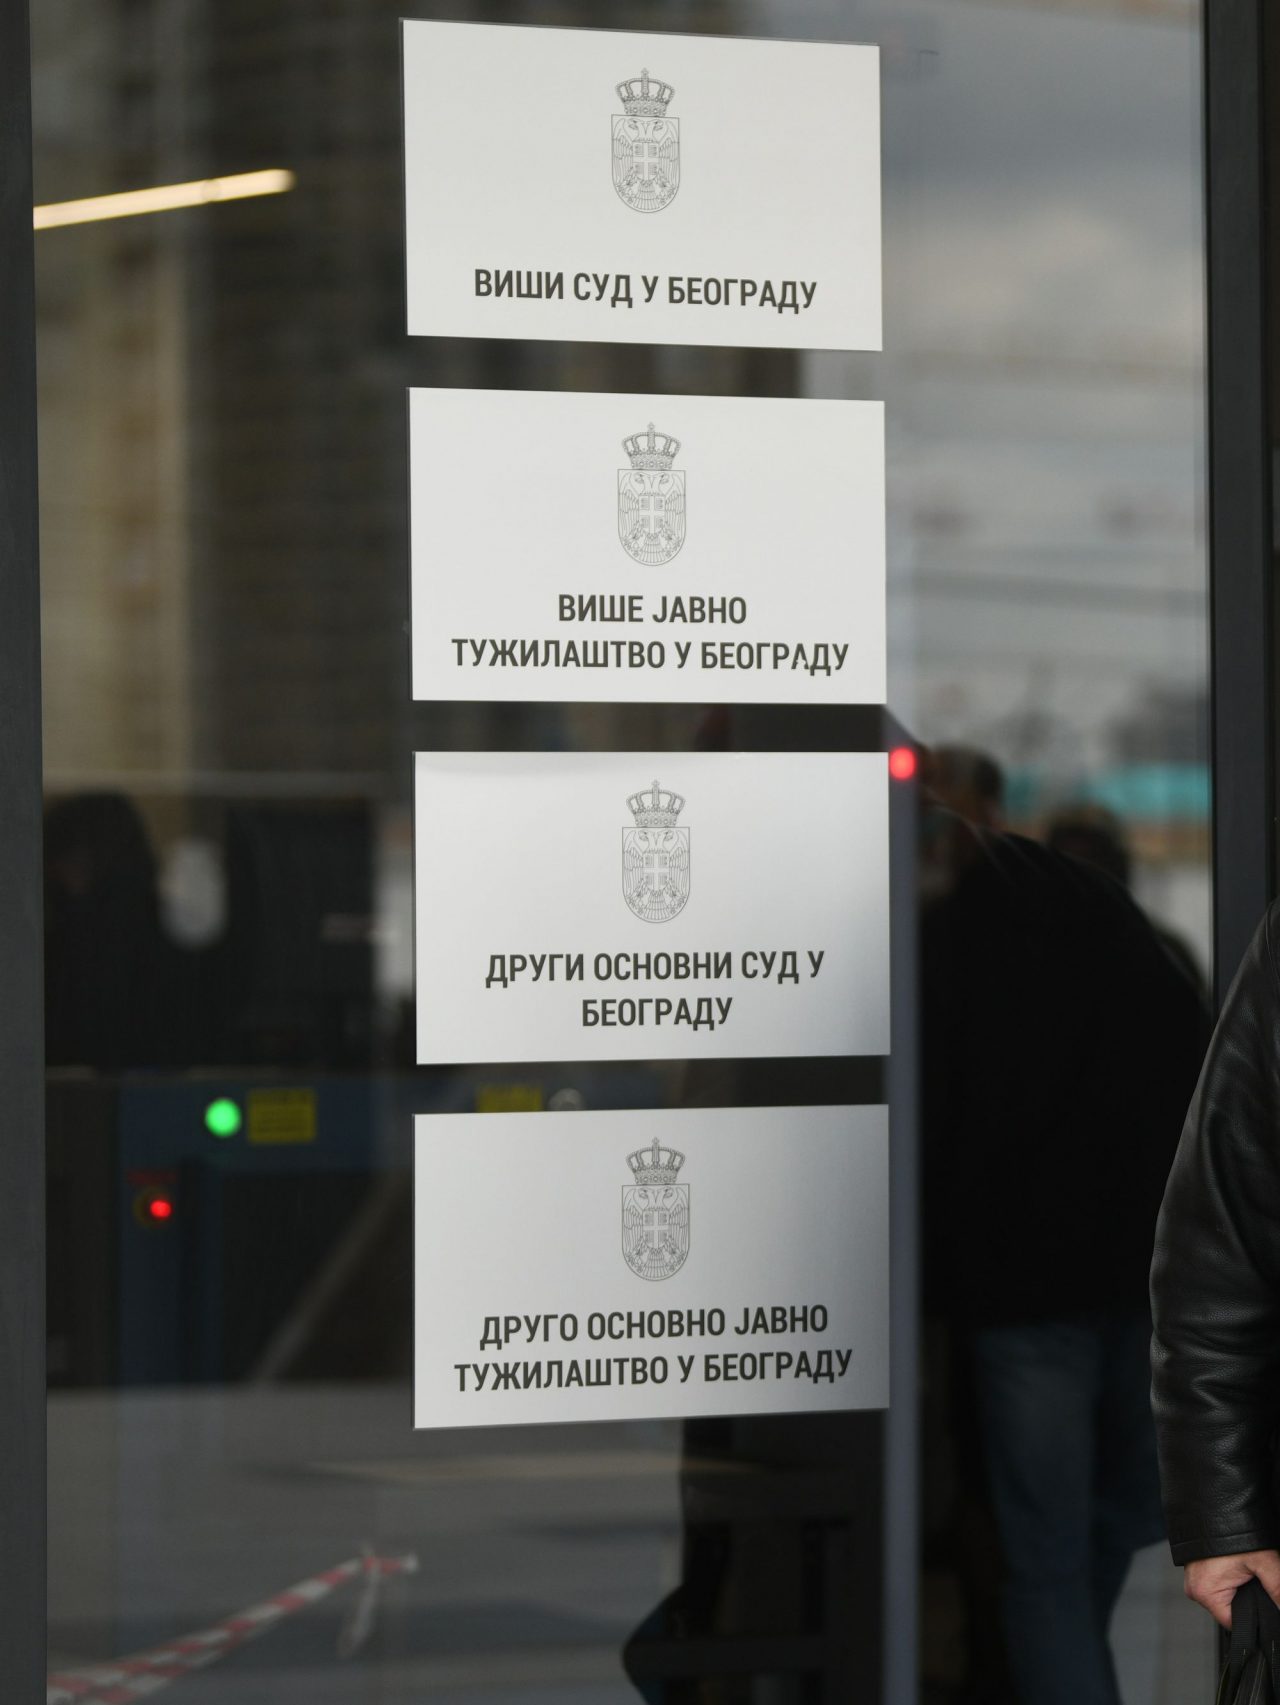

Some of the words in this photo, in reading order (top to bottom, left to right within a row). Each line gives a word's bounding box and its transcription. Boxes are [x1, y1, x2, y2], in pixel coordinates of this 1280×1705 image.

[474, 268, 564, 300] ВИШИ
[573, 272, 633, 309] СУД
[641, 275, 659, 303] У
[668, 276, 817, 315] БЕОГРАДУ
[558, 593, 644, 623] ВИШЕ
[652, 595, 747, 625] ЈАВНО
[451, 638, 666, 669] ТУЖИЛАШТВО
[674, 641, 692, 669] У
[701, 641, 849, 677] БЕОГРАДУ
[485, 953, 584, 989] ДРУГИ
[593, 951, 732, 981] ОСНОВНИ
[741, 950, 800, 985] СУД
[807, 950, 825, 979] У
[582, 996, 733, 1032] БЕОГРАДУ
[479, 1313, 579, 1352] ДРУГО
[587, 1307, 726, 1341] ОСНОВНО
[733, 1304, 829, 1336] ЈАВНО
[453, 1355, 669, 1392] ТУЖИЛАШТВО
[677, 1354, 696, 1384] У
[703, 1348, 853, 1385] БЕОГРАДУ
